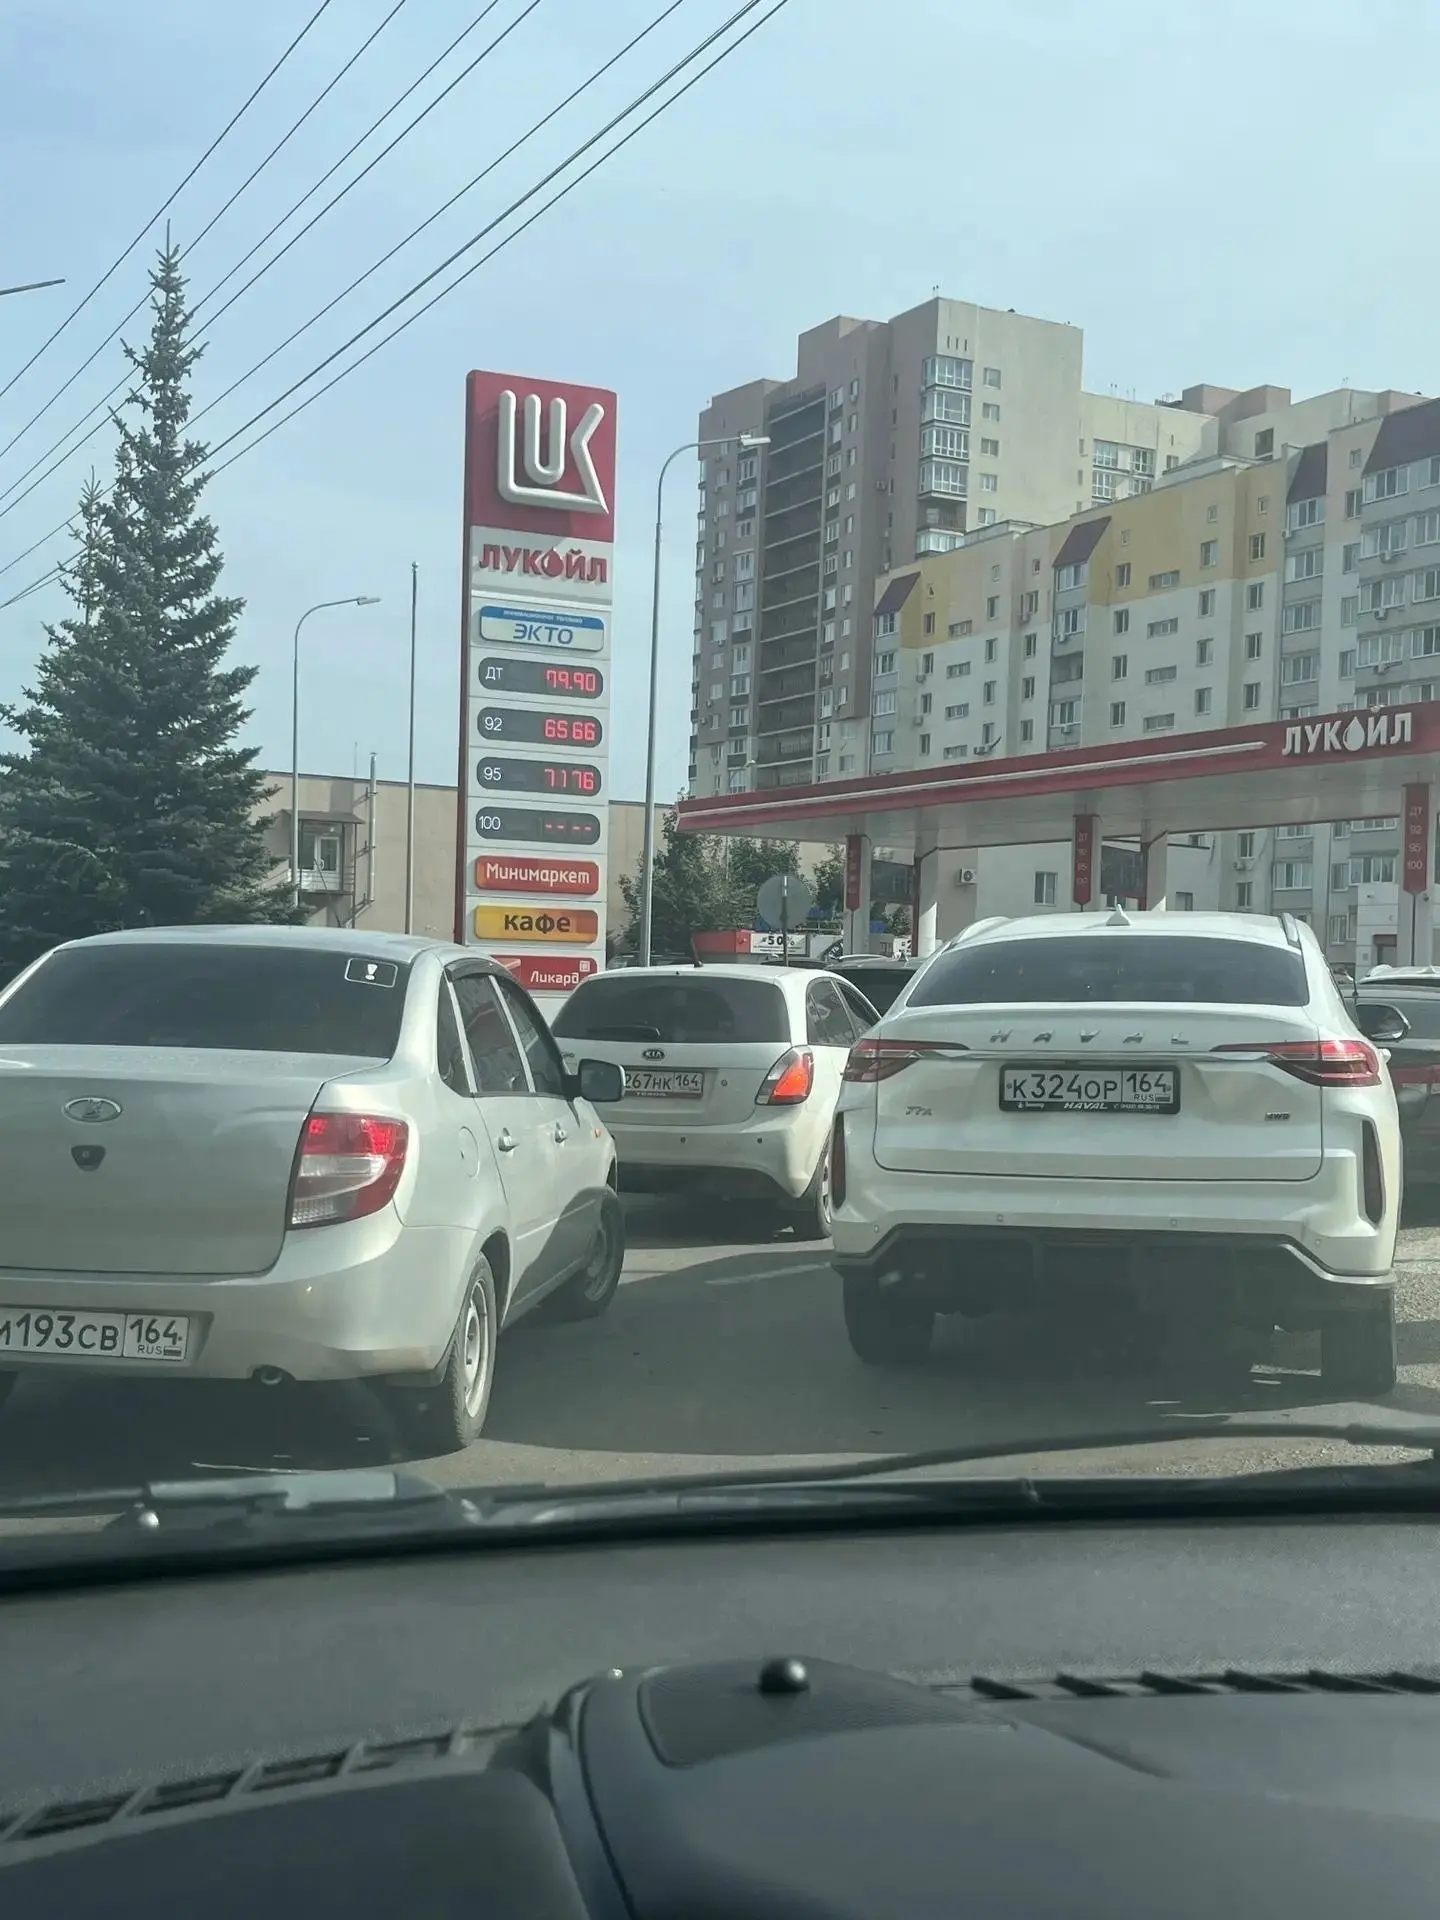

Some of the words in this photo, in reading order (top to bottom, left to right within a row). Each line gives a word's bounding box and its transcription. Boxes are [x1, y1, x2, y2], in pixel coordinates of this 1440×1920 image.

[479, 543, 607, 583] ЛУКОЙЛ
[513, 623, 573, 645] ЭКТО
[485, 666, 503, 681] ДТ
[484, 716, 503, 731] 92
[1281, 704, 1412, 756] ЛУКОЙЛ
[483, 766, 502, 781] 95
[479, 815, 501, 830] 100
[486, 863, 590, 887] Минимаркет
[504, 913, 571, 934] кафе
[530, 970, 580, 987] Ликард
[676, 1074, 698, 1087] 164
[1126, 1073, 1167, 1093] 164
[1133, 1093, 1154, 1102] RUS
[1063, 1102, 1108, 1110] HAVAL
[130, 1317, 179, 1346] 164
[137, 1344, 163, 1356] RUS
